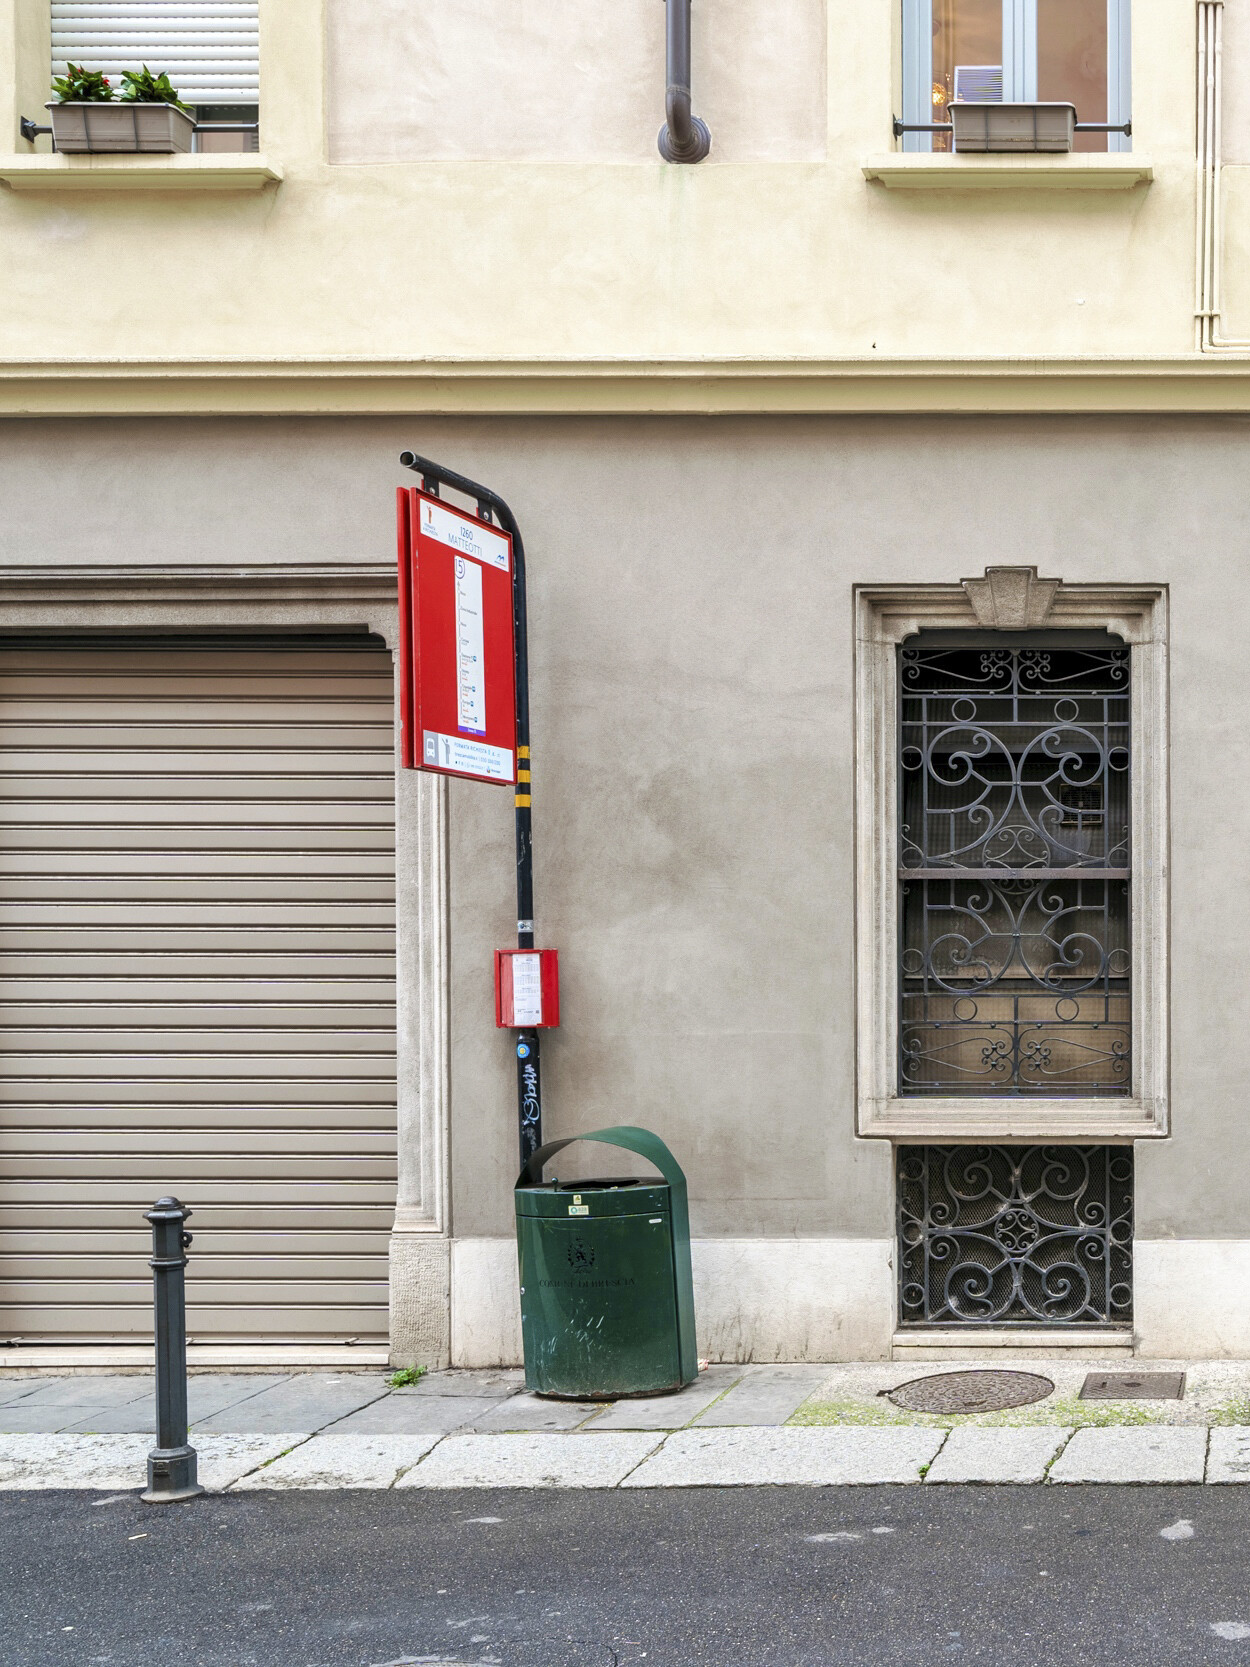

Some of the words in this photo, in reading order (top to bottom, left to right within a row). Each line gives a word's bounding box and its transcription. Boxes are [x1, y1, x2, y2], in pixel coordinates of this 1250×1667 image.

[460, 526, 473, 541] 1260
[448, 533, 482, 557] MATTEOTTI
[539, 1279, 574, 1288] COMUNE
[591, 1278, 635, 1288] BRESCIA
